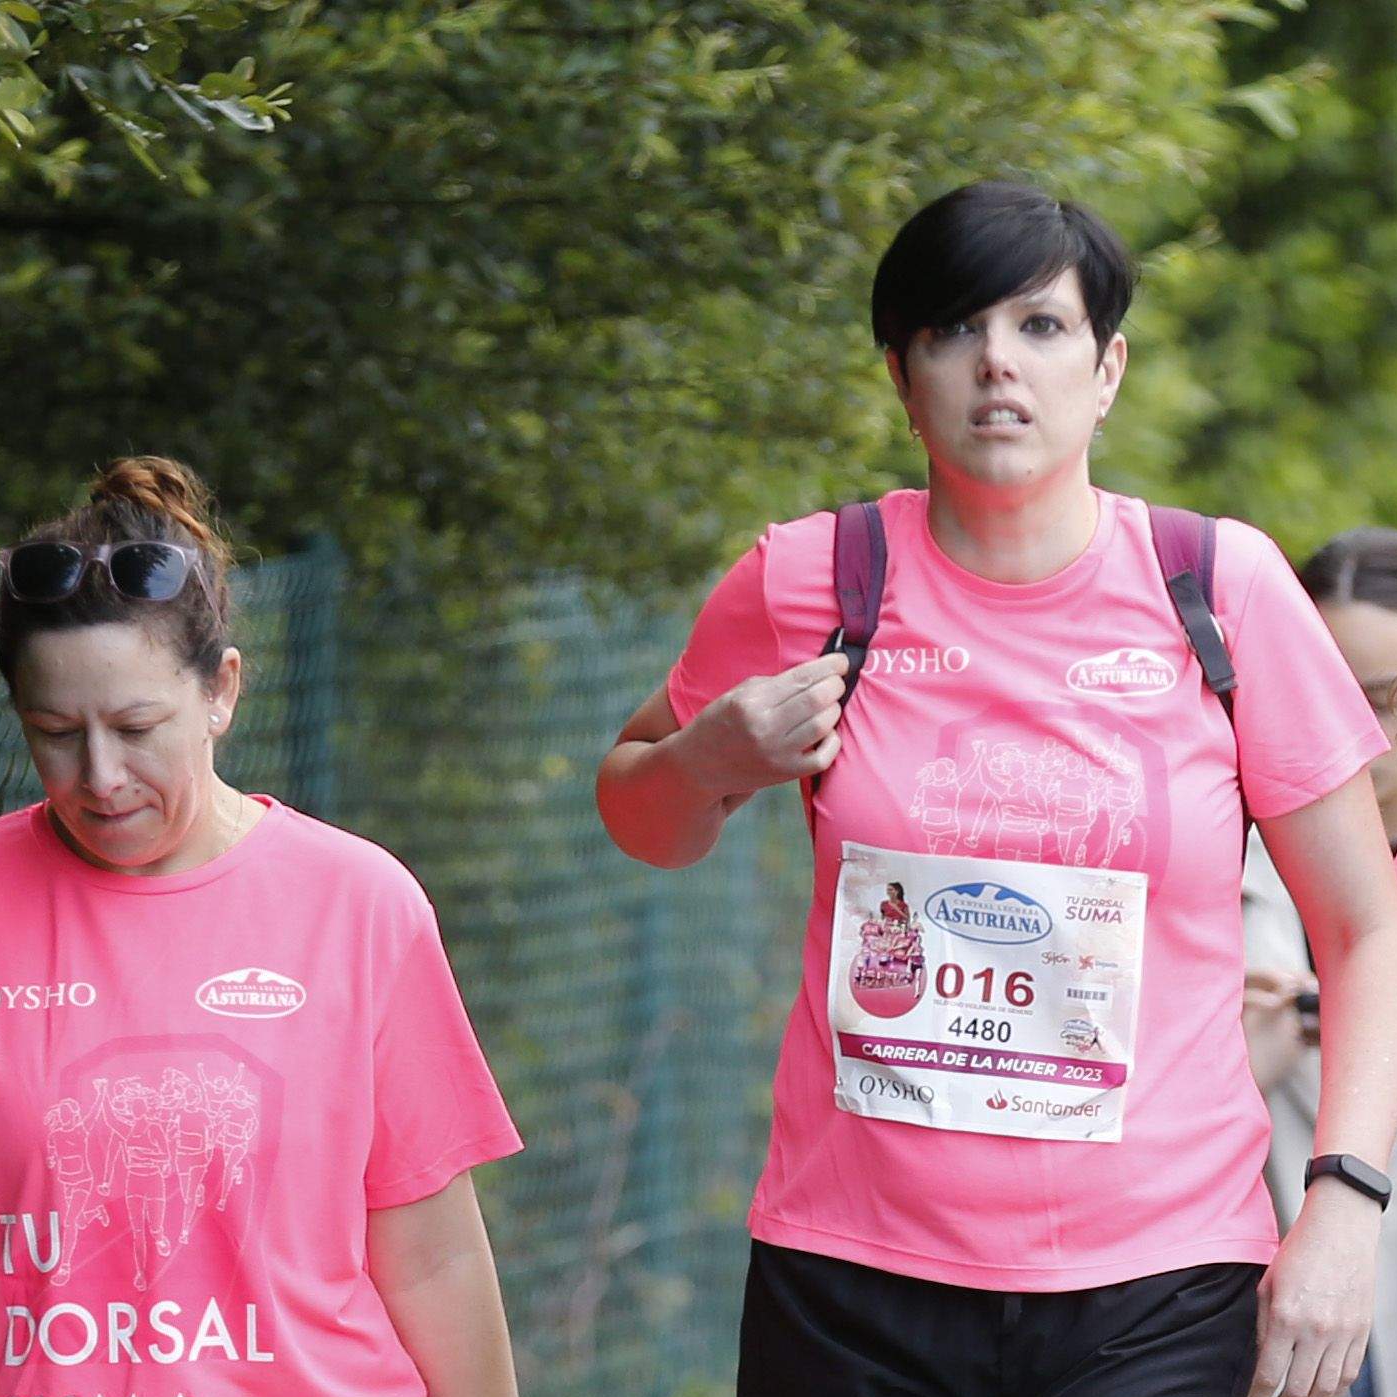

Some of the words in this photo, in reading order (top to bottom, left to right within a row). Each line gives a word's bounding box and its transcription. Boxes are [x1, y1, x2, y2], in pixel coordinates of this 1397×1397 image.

[1077, 666, 1169, 687] ASTURIANA
[934, 898, 1042, 934] ASTURIANA
[1065, 906, 1122, 924] SUMA
[1066, 896, 1080, 904] TU
[1082, 897, 1124, 909] DORSAL
[205, 986, 297, 1006] ASTURIANA
[935, 963, 1035, 1007] 016
[948, 1016, 1012, 1043] 4480
[862, 1043, 938, 1063] CARRERA
[942, 1051, 969, 1067] DE
[970, 1054, 993, 1069] LA
[997, 1057, 1058, 1076] MUJER
[1063, 1065, 1103, 1081] 2023
[859, 1075, 935, 1104] OYSHO
[1011, 1095, 1102, 1117] Santander
[0, 1211, 61, 1274] TU
[5, 1297, 275, 1366] DORSAL
